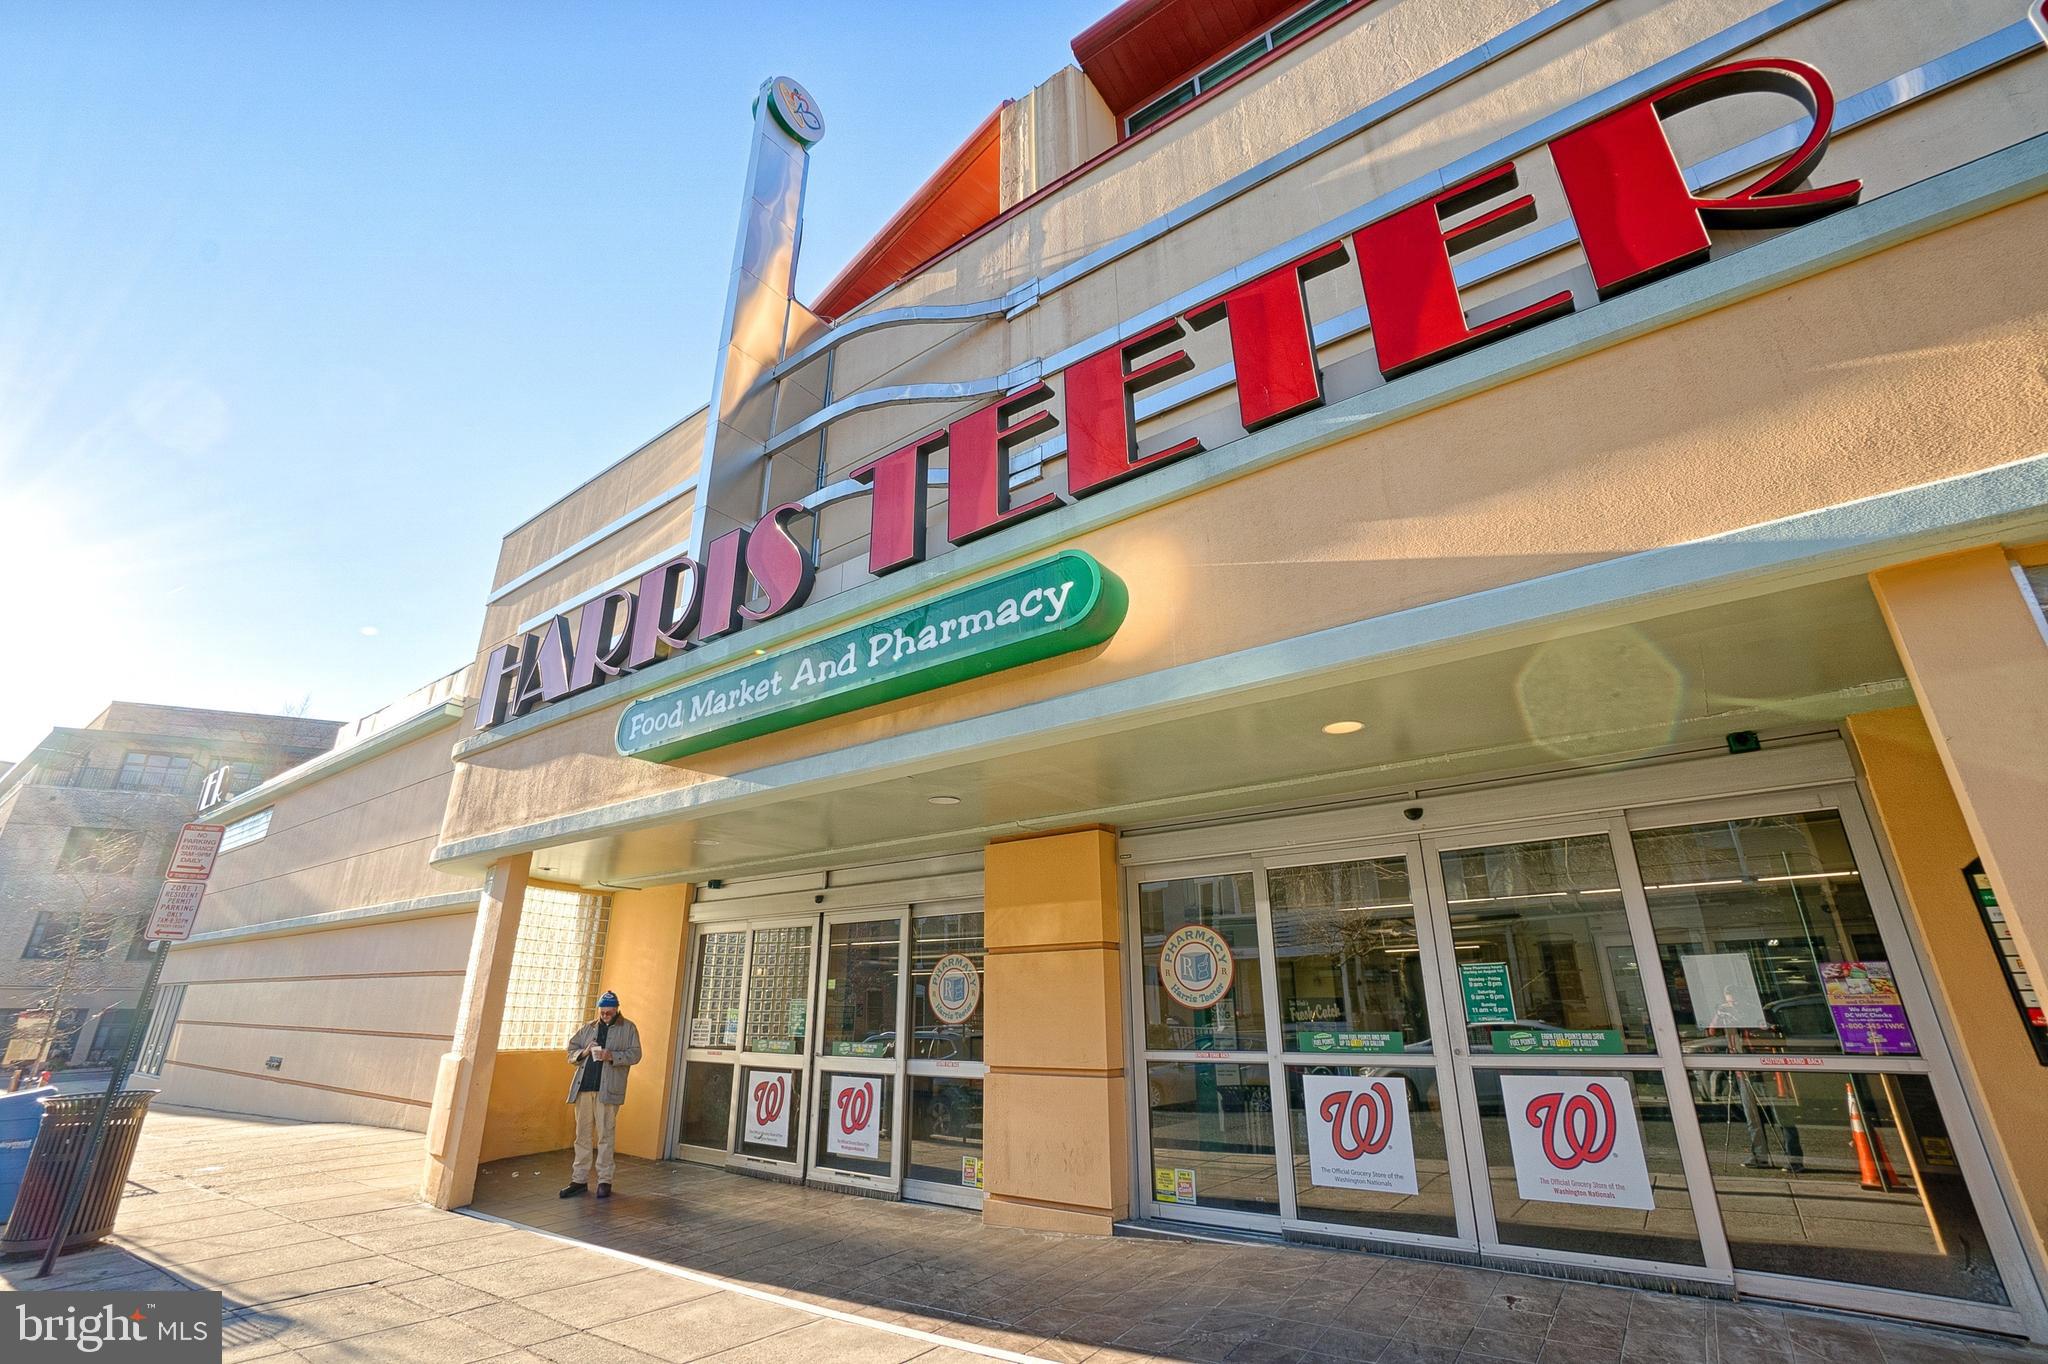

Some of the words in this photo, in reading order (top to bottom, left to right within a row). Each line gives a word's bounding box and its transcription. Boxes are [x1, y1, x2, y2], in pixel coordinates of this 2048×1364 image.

[474, 502, 816, 731] HARRIS
[850, 57, 1863, 576] TEETER
[628, 702, 684, 740] Food
[689, 669, 784, 718] Market
[790, 642, 858, 692] And
[868, 581, 1075, 667] Pharmacy
[1164, 930, 1228, 963] PHARMACY
[932, 958, 976, 986] PHARMACY
[1171, 984, 1198, 1003] Harris
[1198, 983, 1224, 1003] Teeter
[754, 1076, 785, 1126] W
[838, 1082, 874, 1135] W
[1320, 1082, 1393, 1160] W
[1525, 1083, 1616, 1170] W
[1331, 1167, 1350, 1175] Official
[1350, 1169, 1371, 1178] Grocery
[1372, 1170, 1387, 1178] Store
[1388, 1171, 1394, 1179] of
[1335, 1176, 1366, 1185] Washington
[1367, 1179, 1392, 1187] Nationals
[1550, 1178, 1570, 1187] Official
[1571, 1180, 1592, 1190] Grocery
[1592, 1181, 1607, 1189] Store
[1608, 1182, 1614, 1190] of
[1553, 1187, 1587, 1197] Washington
[1587, 1190, 1616, 1199] Nationals
